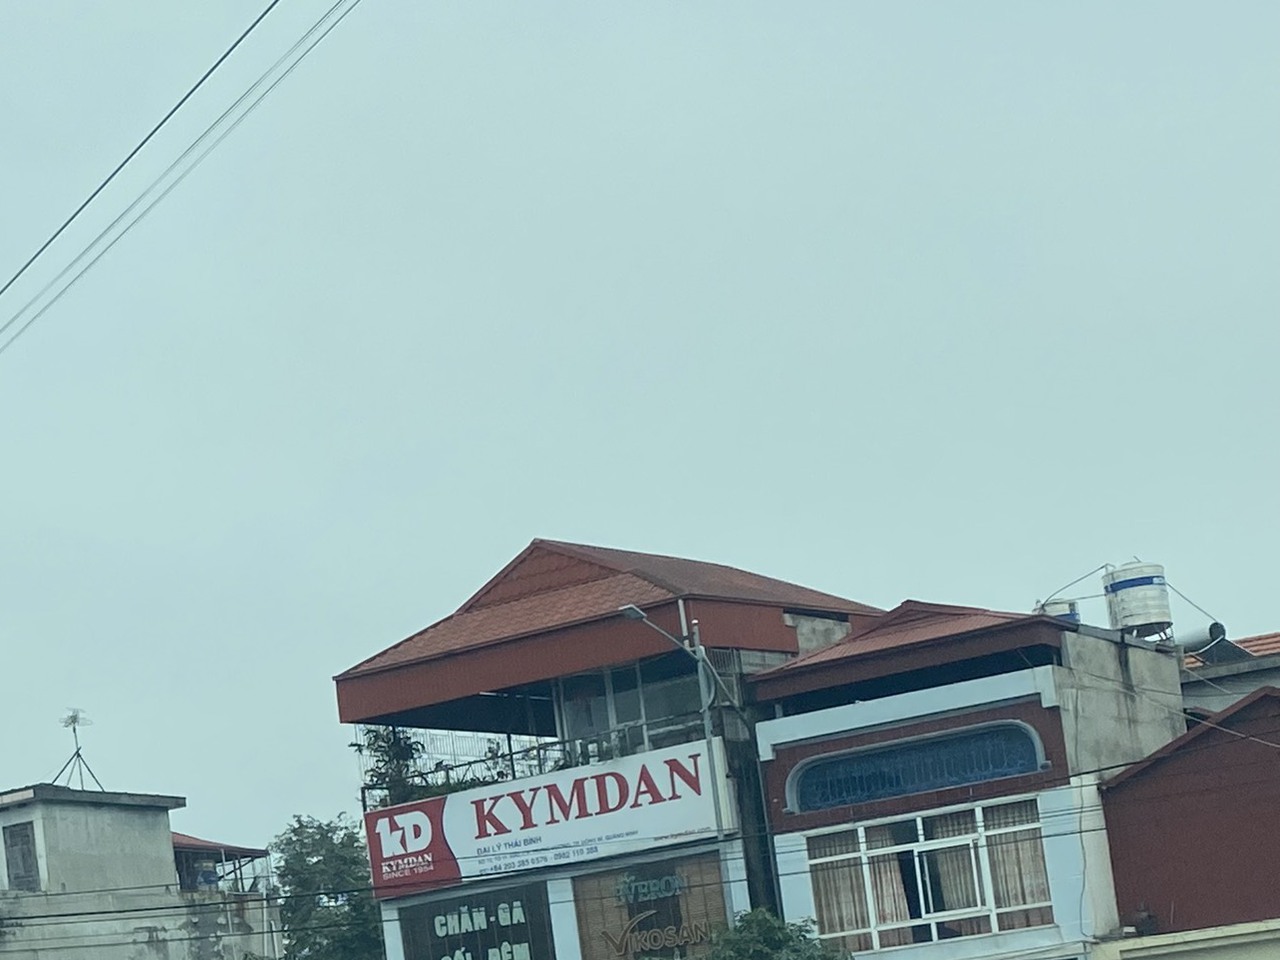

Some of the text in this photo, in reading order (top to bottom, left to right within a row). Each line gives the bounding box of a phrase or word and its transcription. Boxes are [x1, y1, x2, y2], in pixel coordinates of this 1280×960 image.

[471, 754, 701, 839] KYMDAN
[381, 853, 433, 873] KYMDAN
[383, 868, 412, 880] SINCE
[434, 905, 488, 937] CHĂN
[498, 901, 525, 926] GA
[601, 910, 711, 956] VIKOSAN
